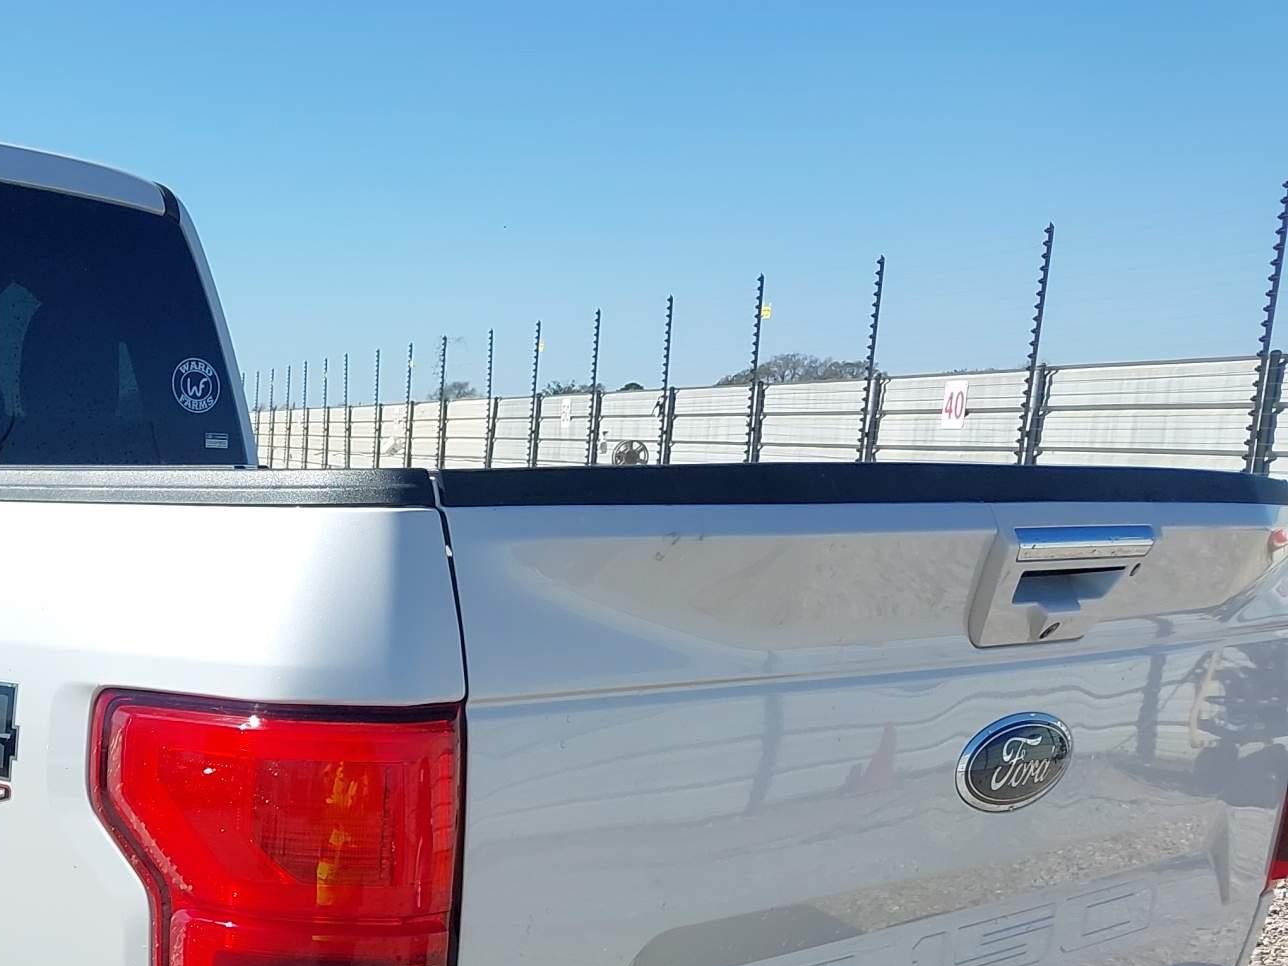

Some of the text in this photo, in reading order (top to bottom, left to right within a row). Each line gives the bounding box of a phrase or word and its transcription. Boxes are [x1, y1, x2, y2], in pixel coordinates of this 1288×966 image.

[179, 361, 213, 377] WARD
[179, 394, 214, 411] FARMS
[945, 390, 965, 420] 40
[990, 734, 1053, 792] Ford
